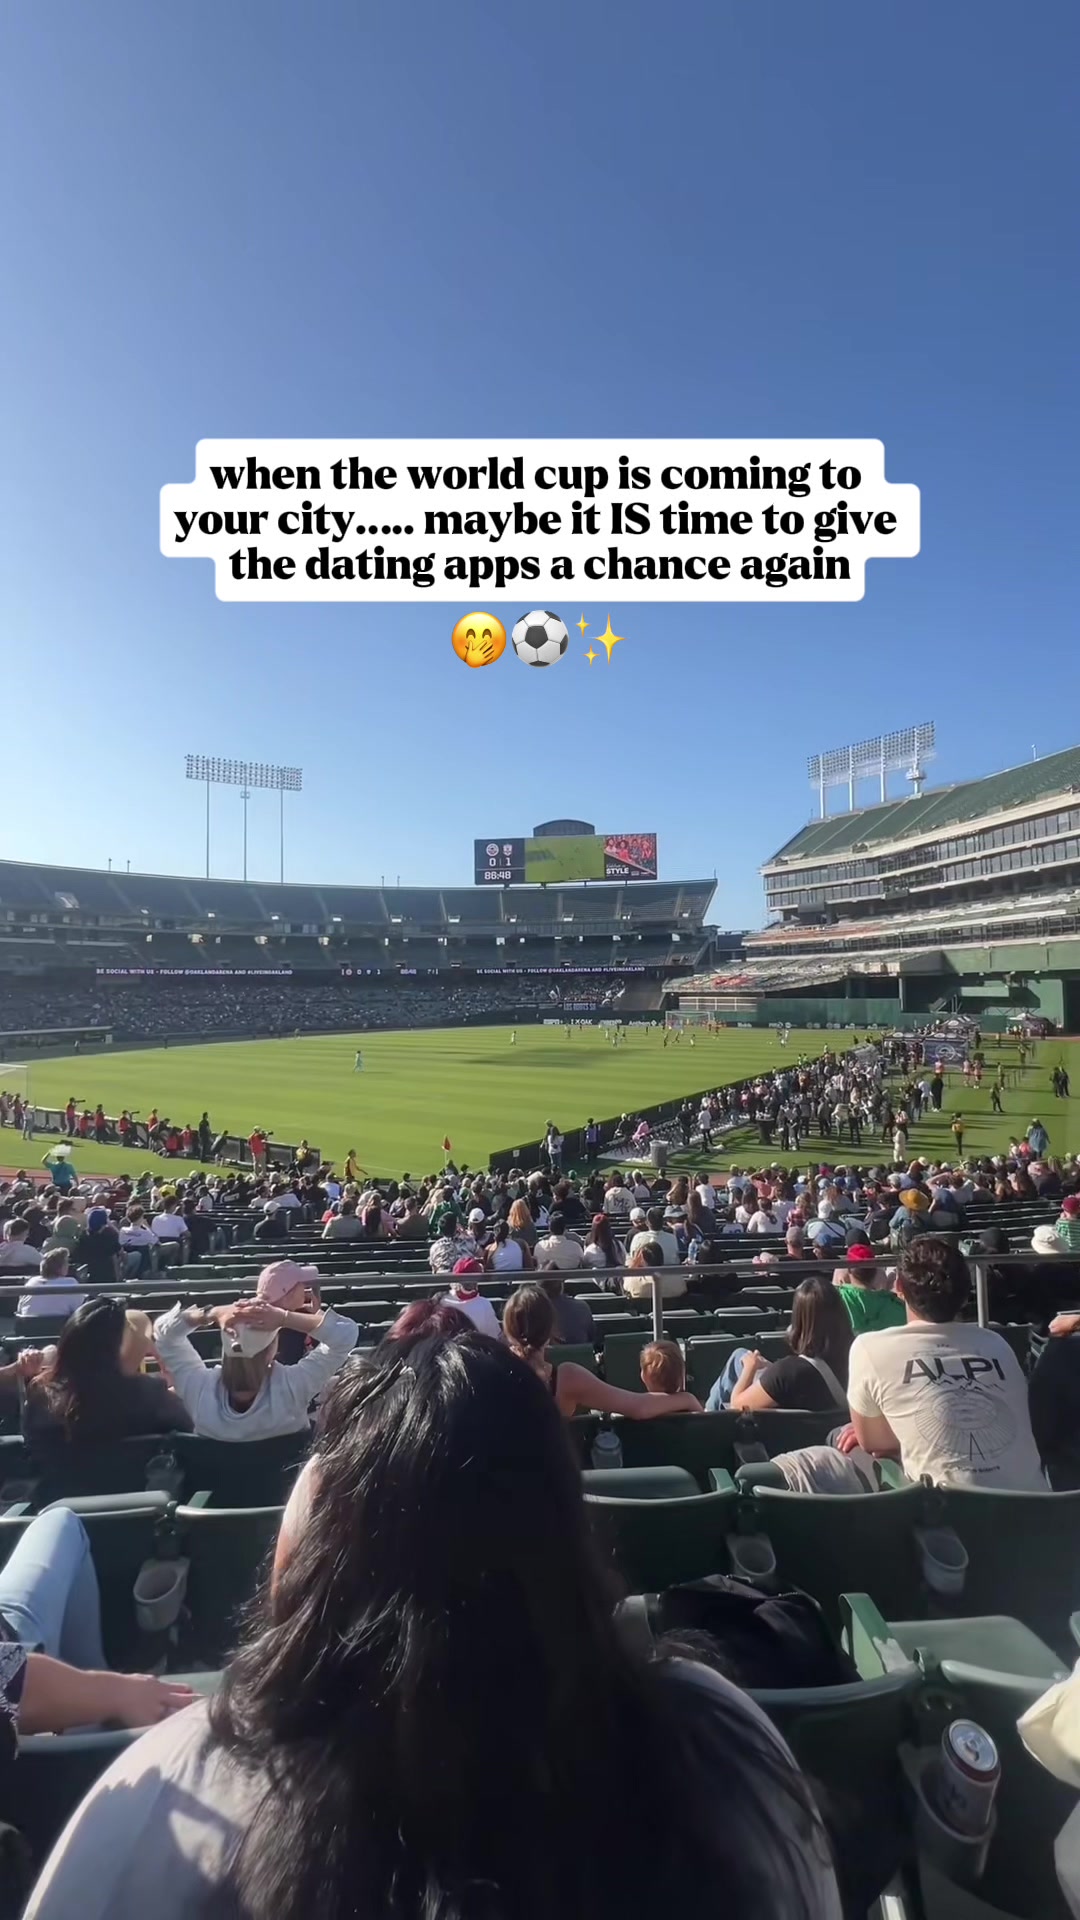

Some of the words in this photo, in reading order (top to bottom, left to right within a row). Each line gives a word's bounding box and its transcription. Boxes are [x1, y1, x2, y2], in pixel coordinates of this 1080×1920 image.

[489, 858, 495, 867] 0
[506, 857, 511, 866] 1
[903, 1357, 1006, 1385] ALPI
